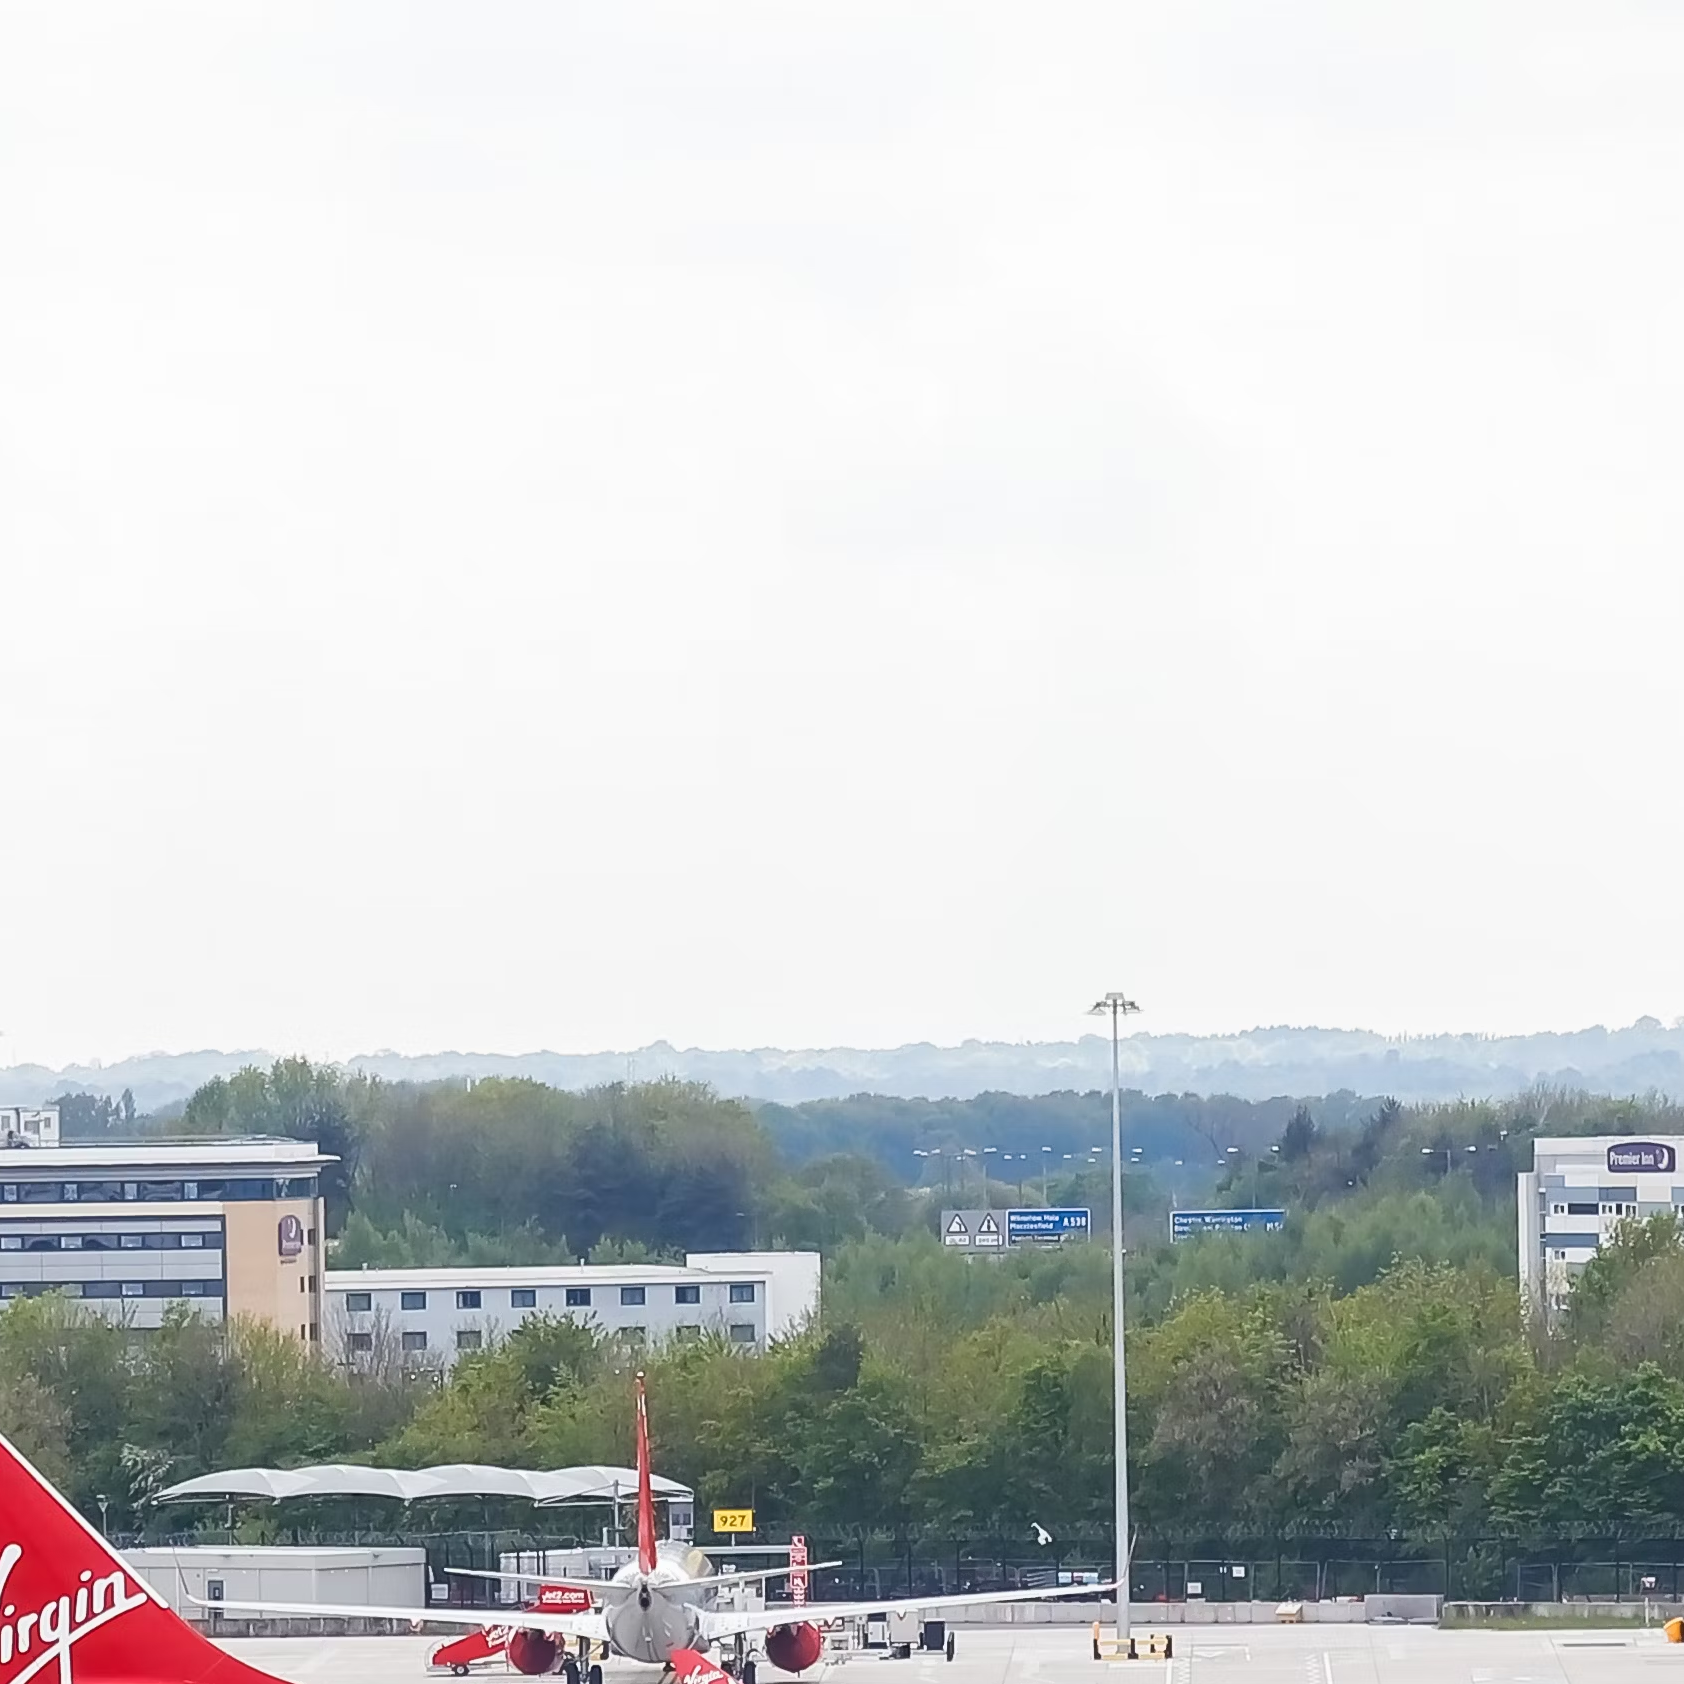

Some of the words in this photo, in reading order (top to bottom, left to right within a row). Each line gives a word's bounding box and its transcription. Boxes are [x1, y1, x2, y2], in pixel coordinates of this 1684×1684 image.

[1610, 1151, 1640, 1165] Premier
[1641, 1151, 1654, 1165] Inn
[719, 1514, 747, 1527] 927
